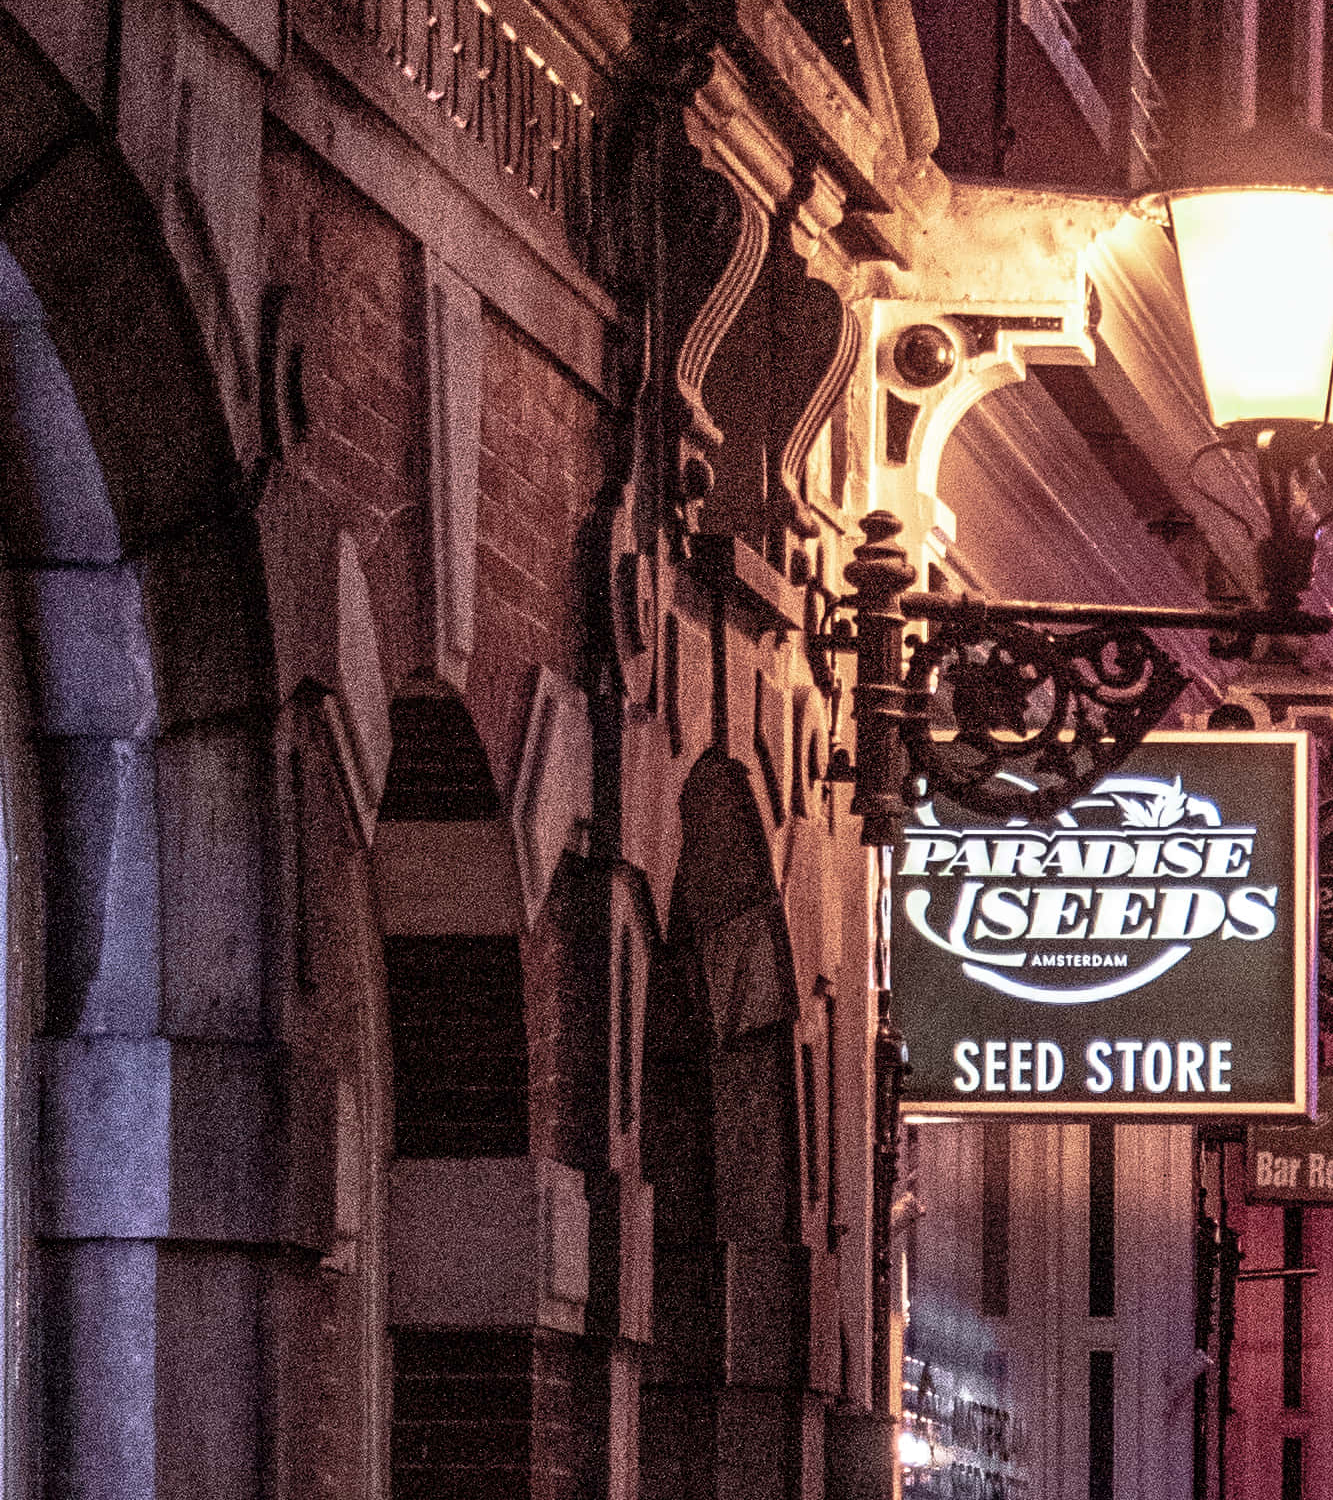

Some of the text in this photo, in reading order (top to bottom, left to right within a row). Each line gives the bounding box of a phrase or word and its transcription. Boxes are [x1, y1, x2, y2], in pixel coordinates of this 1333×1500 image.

[898, 837, 1253, 879] PARADISE
[975, 885, 1279, 942] SEEDS
[1030, 953, 1129, 968] AMSTERDAM
[953, 1040, 1233, 1093] SEED STORE
[1256, 1150, 1299, 1189] Bar
